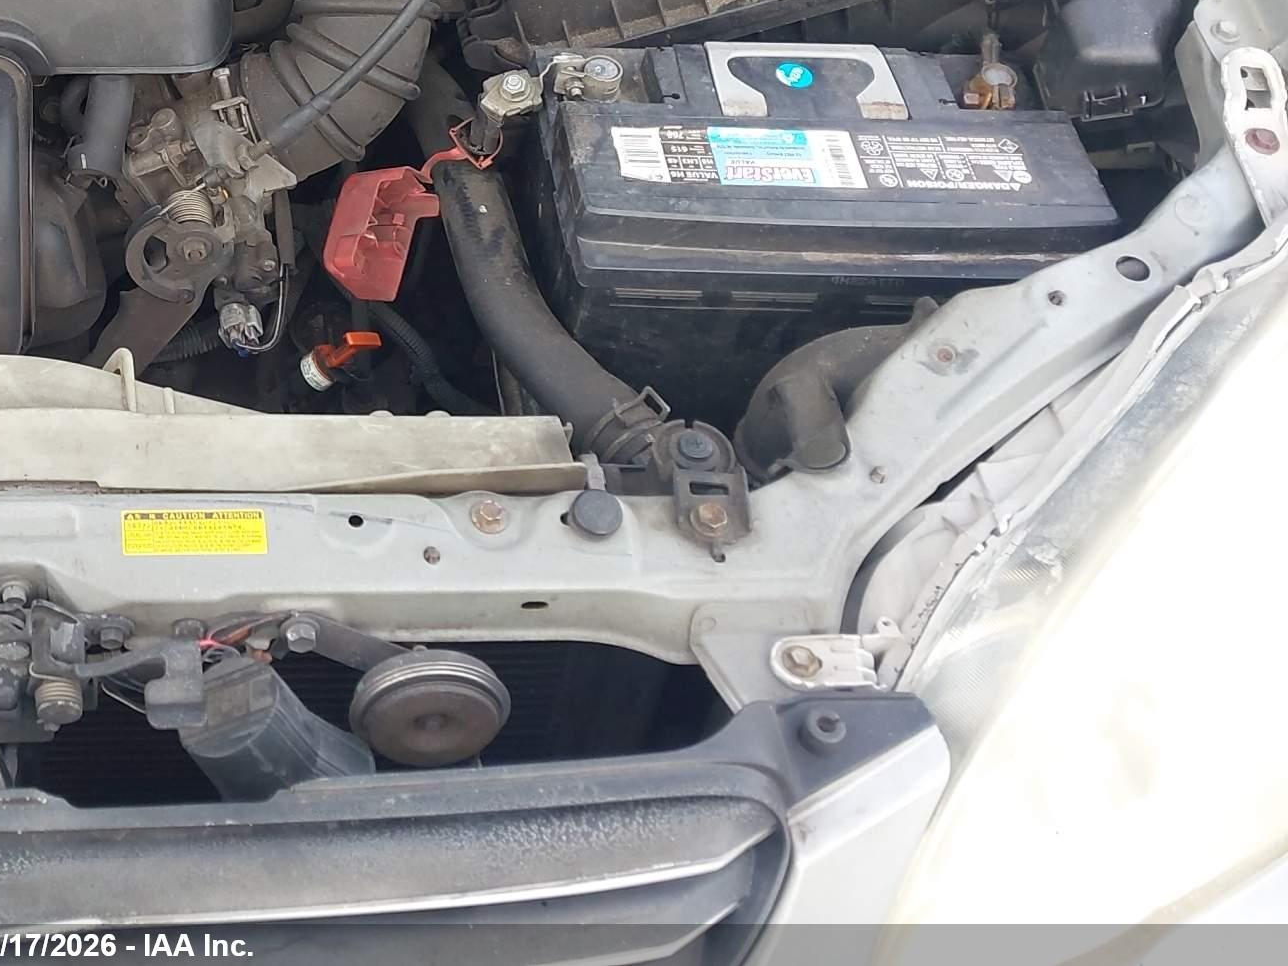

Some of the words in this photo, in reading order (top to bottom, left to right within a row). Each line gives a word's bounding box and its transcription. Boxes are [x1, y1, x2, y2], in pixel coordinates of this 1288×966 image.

[725, 166, 816, 184] EverStart
[163, 512, 206, 520] CAUTION
[212, 511, 260, 520] ATTENTION
